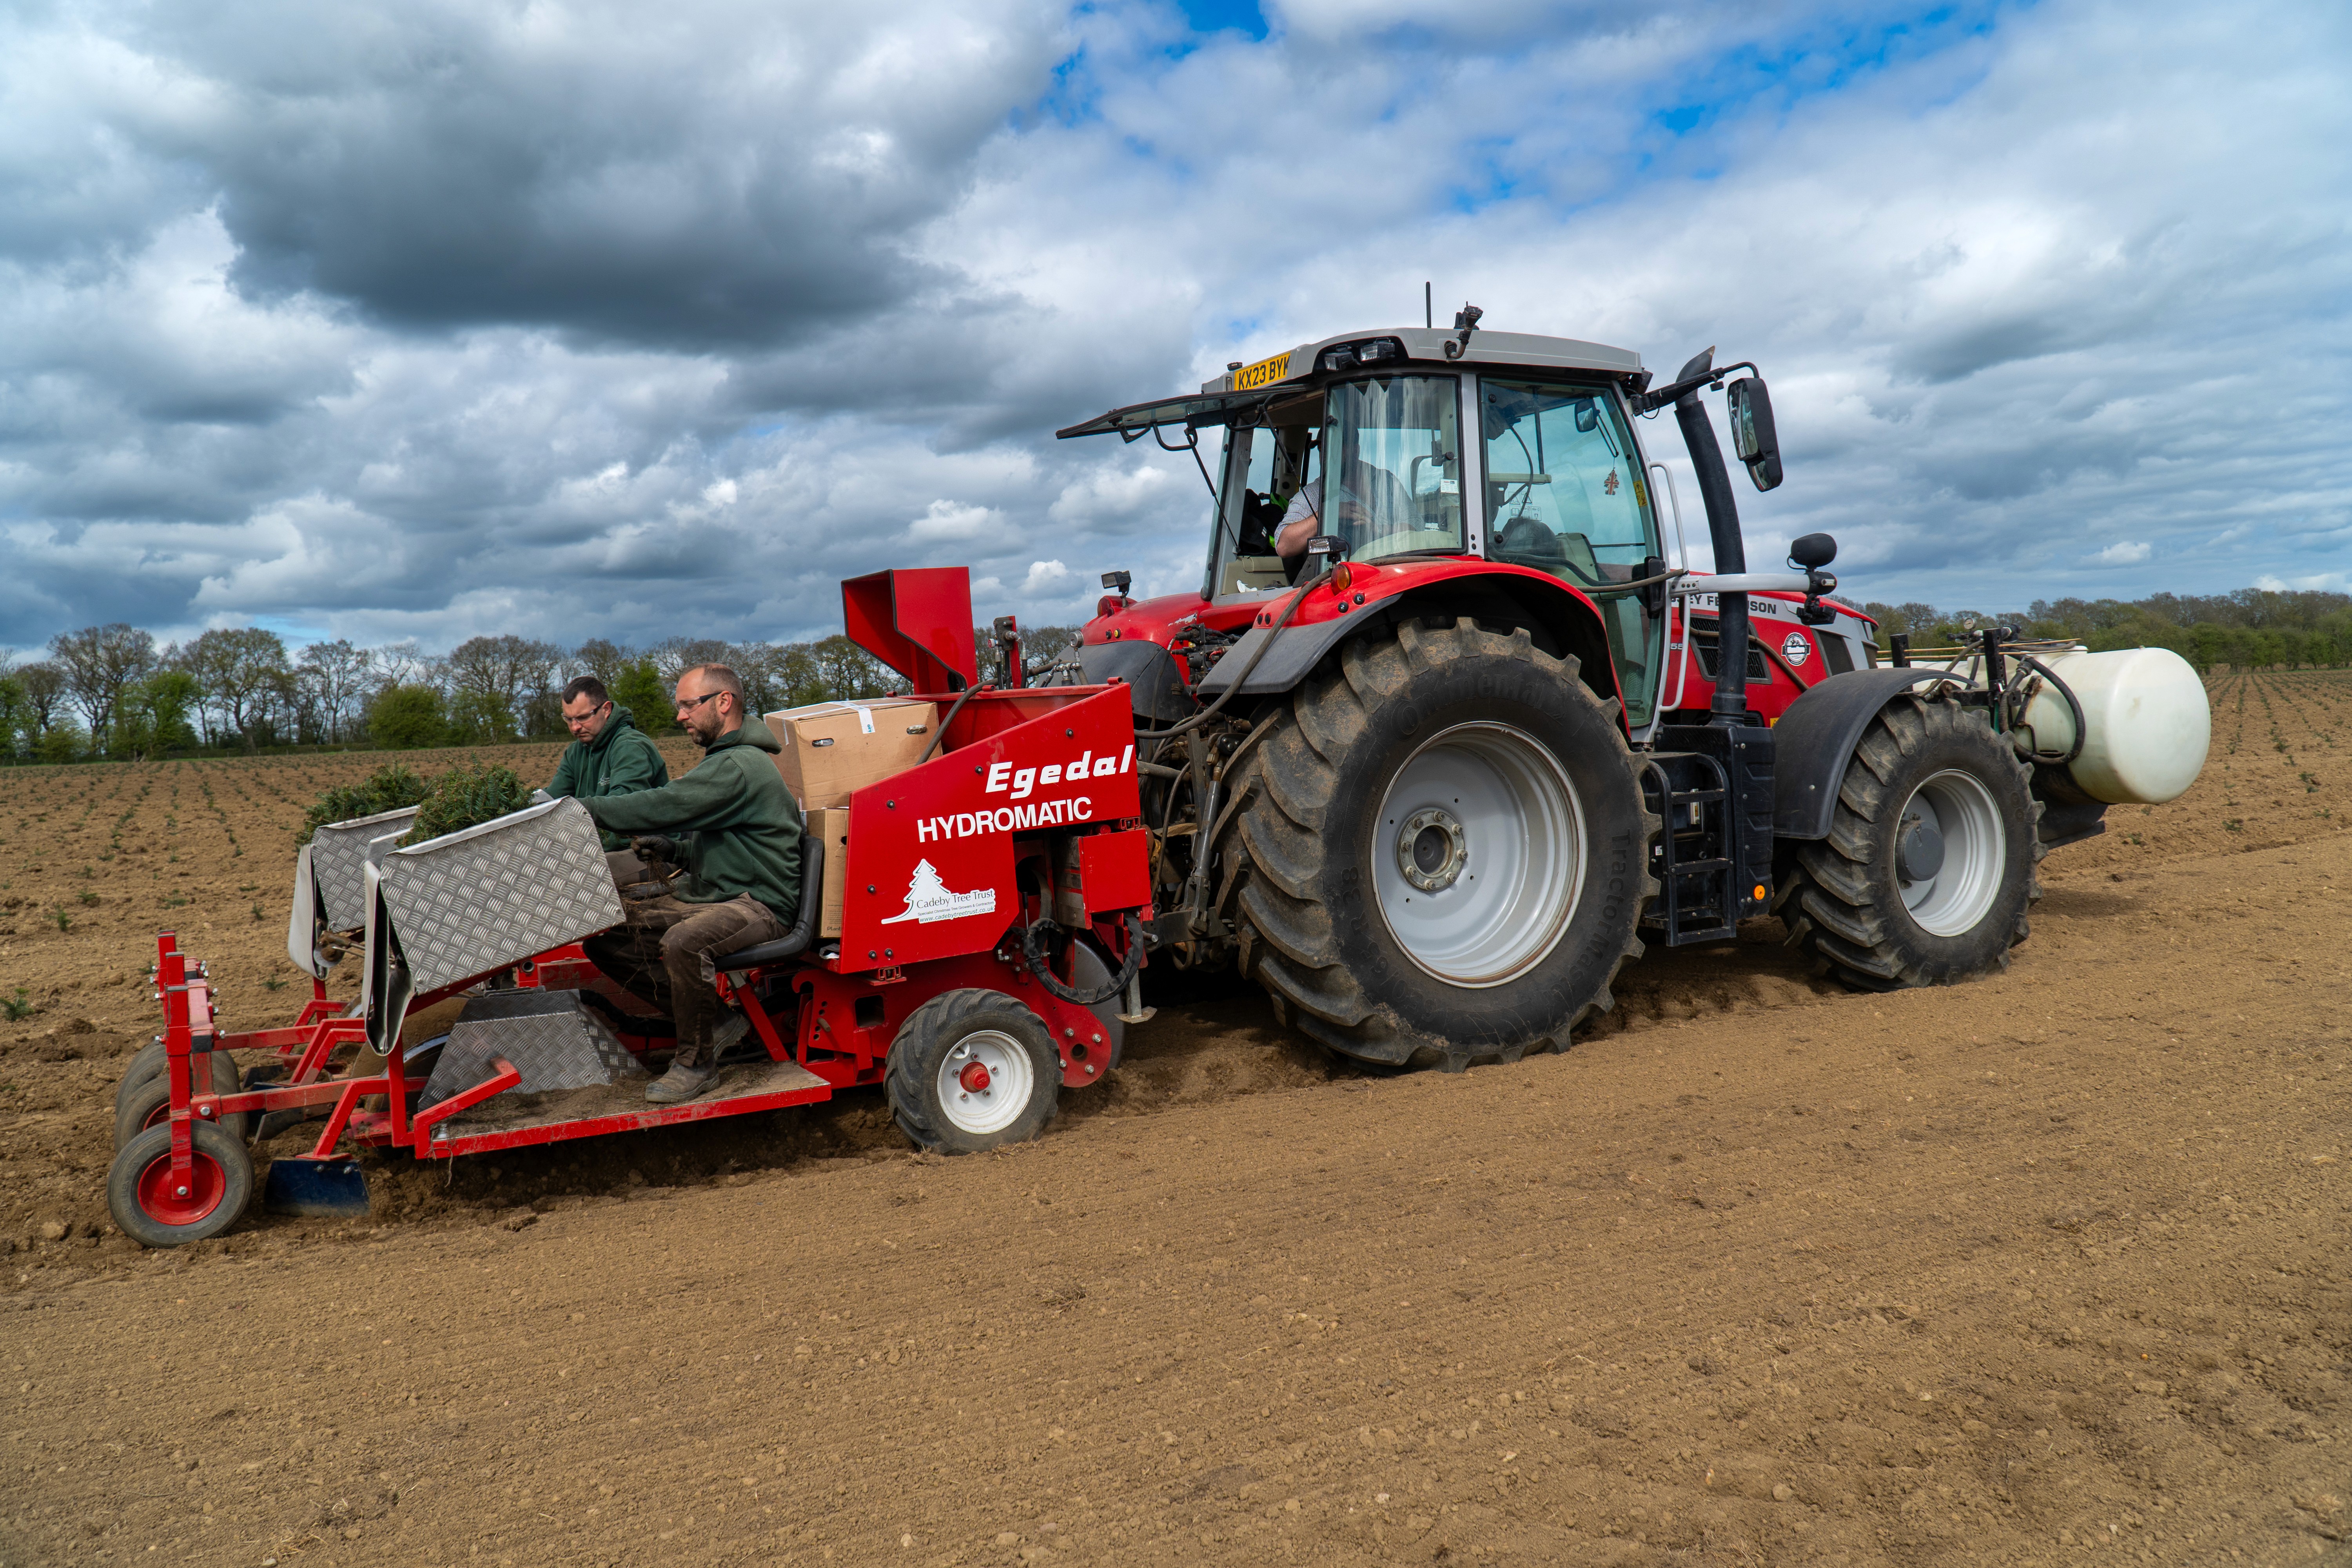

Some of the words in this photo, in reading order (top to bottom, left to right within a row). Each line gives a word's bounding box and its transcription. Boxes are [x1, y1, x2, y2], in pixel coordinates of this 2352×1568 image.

[1239, 364, 1266, 390] KX23
[985, 744, 1134, 799] Egedal
[917, 797, 1092, 843] HYDROMATIC
[916, 896, 950, 908] Cadeby
[952, 895, 971, 903] Tree
[973, 889, 994, 900] Trust
[1341, 865, 1361, 907] 38
[920, 906, 994, 922] www.cadebytreetrust.co.uk
